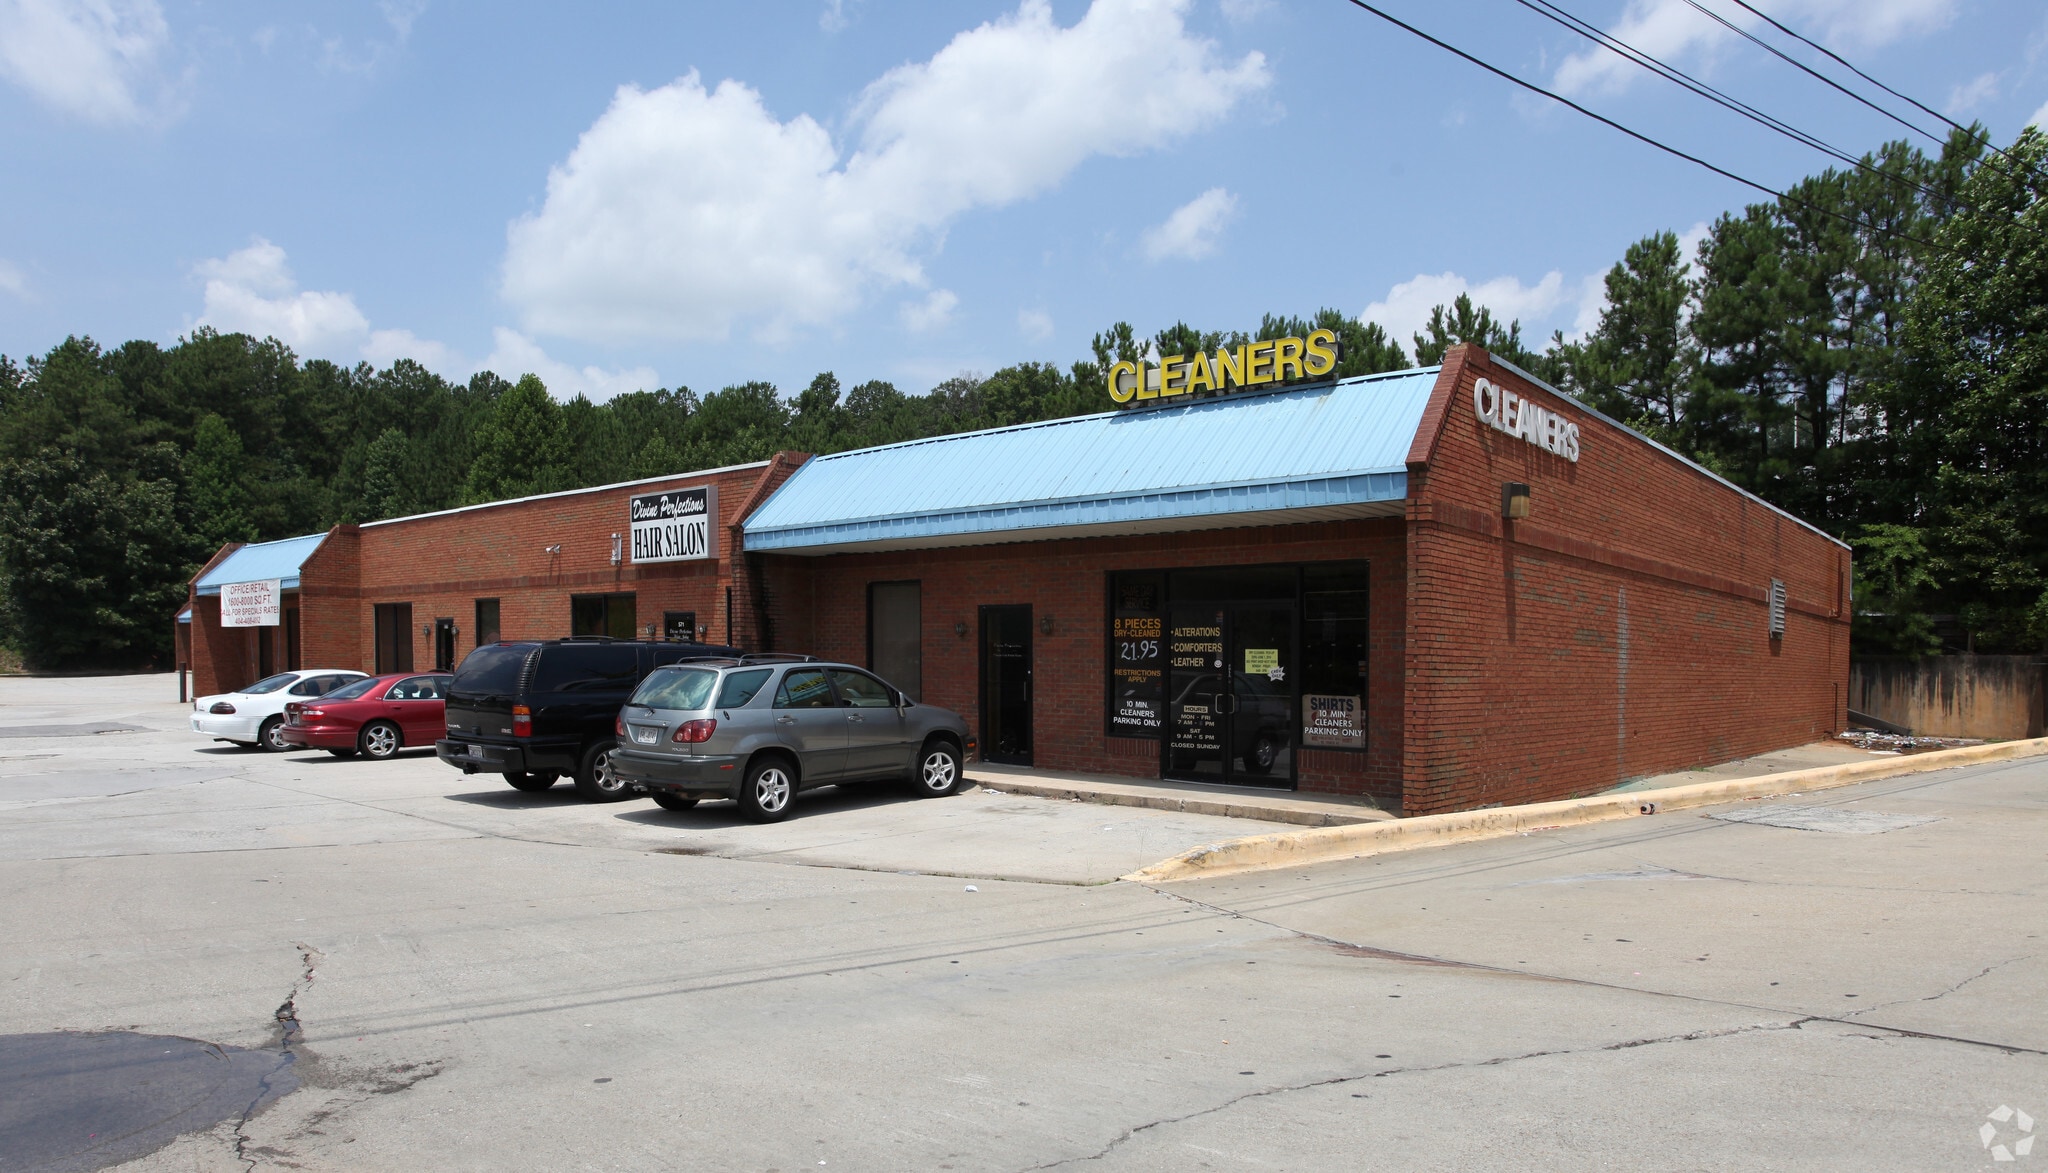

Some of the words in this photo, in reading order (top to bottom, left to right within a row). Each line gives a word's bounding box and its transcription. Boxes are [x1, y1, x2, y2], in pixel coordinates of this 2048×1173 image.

[1108, 328, 1339, 403] CLEANERS
[1474, 377, 1579, 463] CLEANERS
[633, 499, 658, 520] Divine
[660, 495, 704, 521] Perfections
[634, 526, 663, 560] HAIR
[666, 521, 705, 558] SALON
[231, 584, 249, 595] OFFICE
[1114, 619, 1121, 628] 8
[1125, 619, 1160, 628] PIECES
[1114, 629, 1160, 638] DRY-CLEANED
[1174, 627, 1220, 637] ALTERATIONS
[1121, 640, 1158, 660] 21.95
[1174, 643, 1222, 652] COMFORTERS
[1174, 658, 1204, 667] LEATHER
[1114, 669, 1161, 677] RESTRICTIONS
[1311, 697, 1354, 712] SHIRTS
[1120, 709, 1155, 718] CLEANERS
[1113, 717, 1142, 726] PARKING
[1144, 719, 1161, 727] ONLY
[1314, 718, 1353, 728] CLEANERS
[1304, 726, 1339, 736] PARKING
[1341, 728, 1363, 737] ONLY
